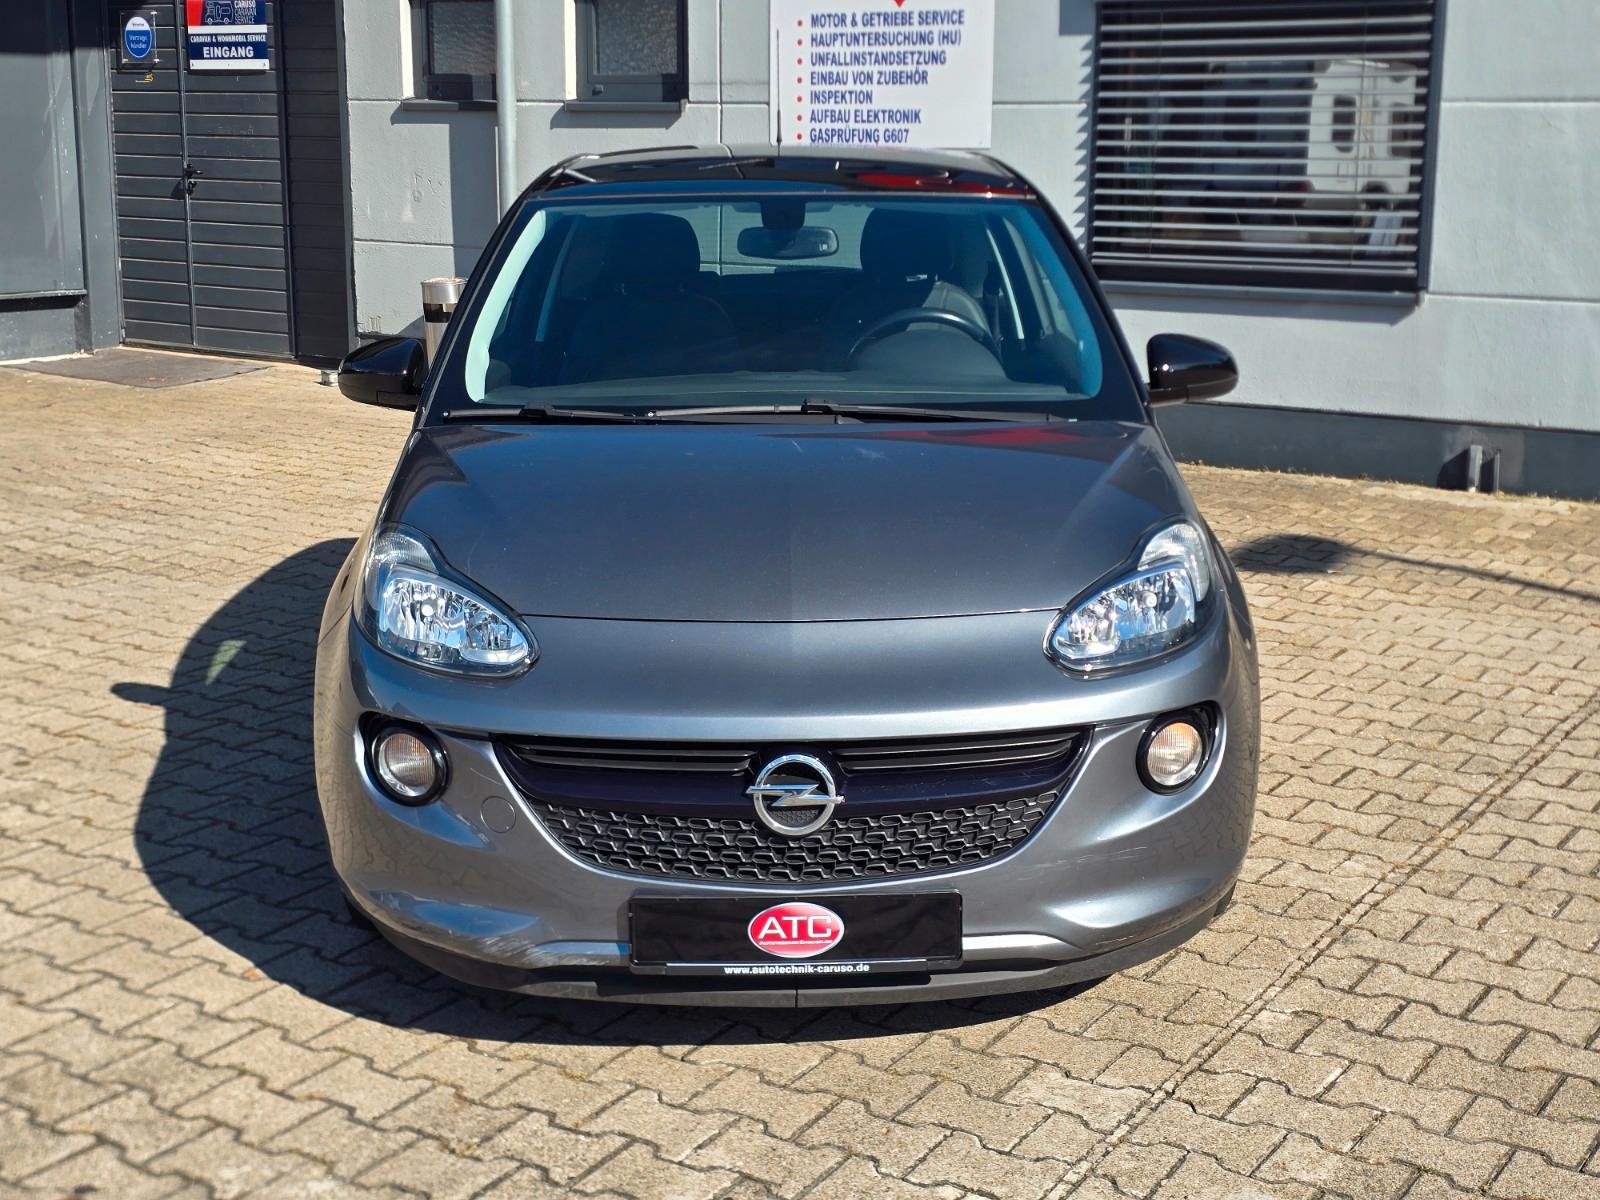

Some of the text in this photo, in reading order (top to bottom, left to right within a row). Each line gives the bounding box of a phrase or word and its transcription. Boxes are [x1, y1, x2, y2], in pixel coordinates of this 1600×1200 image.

[234, 8, 257, 16] CARAVAN
[811, 10, 965, 28] MOTOR & GETRIEBE SERVICE
[234, 16, 255, 24] SERVICE
[190, 35, 211, 43] CARAVAN
[217, 35, 247, 43] WOHNMOBIL
[247, 34, 267, 42] SERVICE
[811, 30, 961, 47] HAUPTUNTERSUCHUNG (HU)
[203, 46, 254, 58] EINGANG
[811, 50, 947, 66] UNFALLINSTANDSETZUNG
[811, 68, 928, 85] EINBAU VON ZUBEHÖR
[810, 90, 873, 104] INSPEKTION
[810, 109, 921, 124] AUFBAU ELEKTRONIK
[810, 126, 909, 143] GASPRÜFUNG G607
[757, 915, 832, 939] ATC
[724, 963, 870, 974] www.autotechnik-caruso.de
